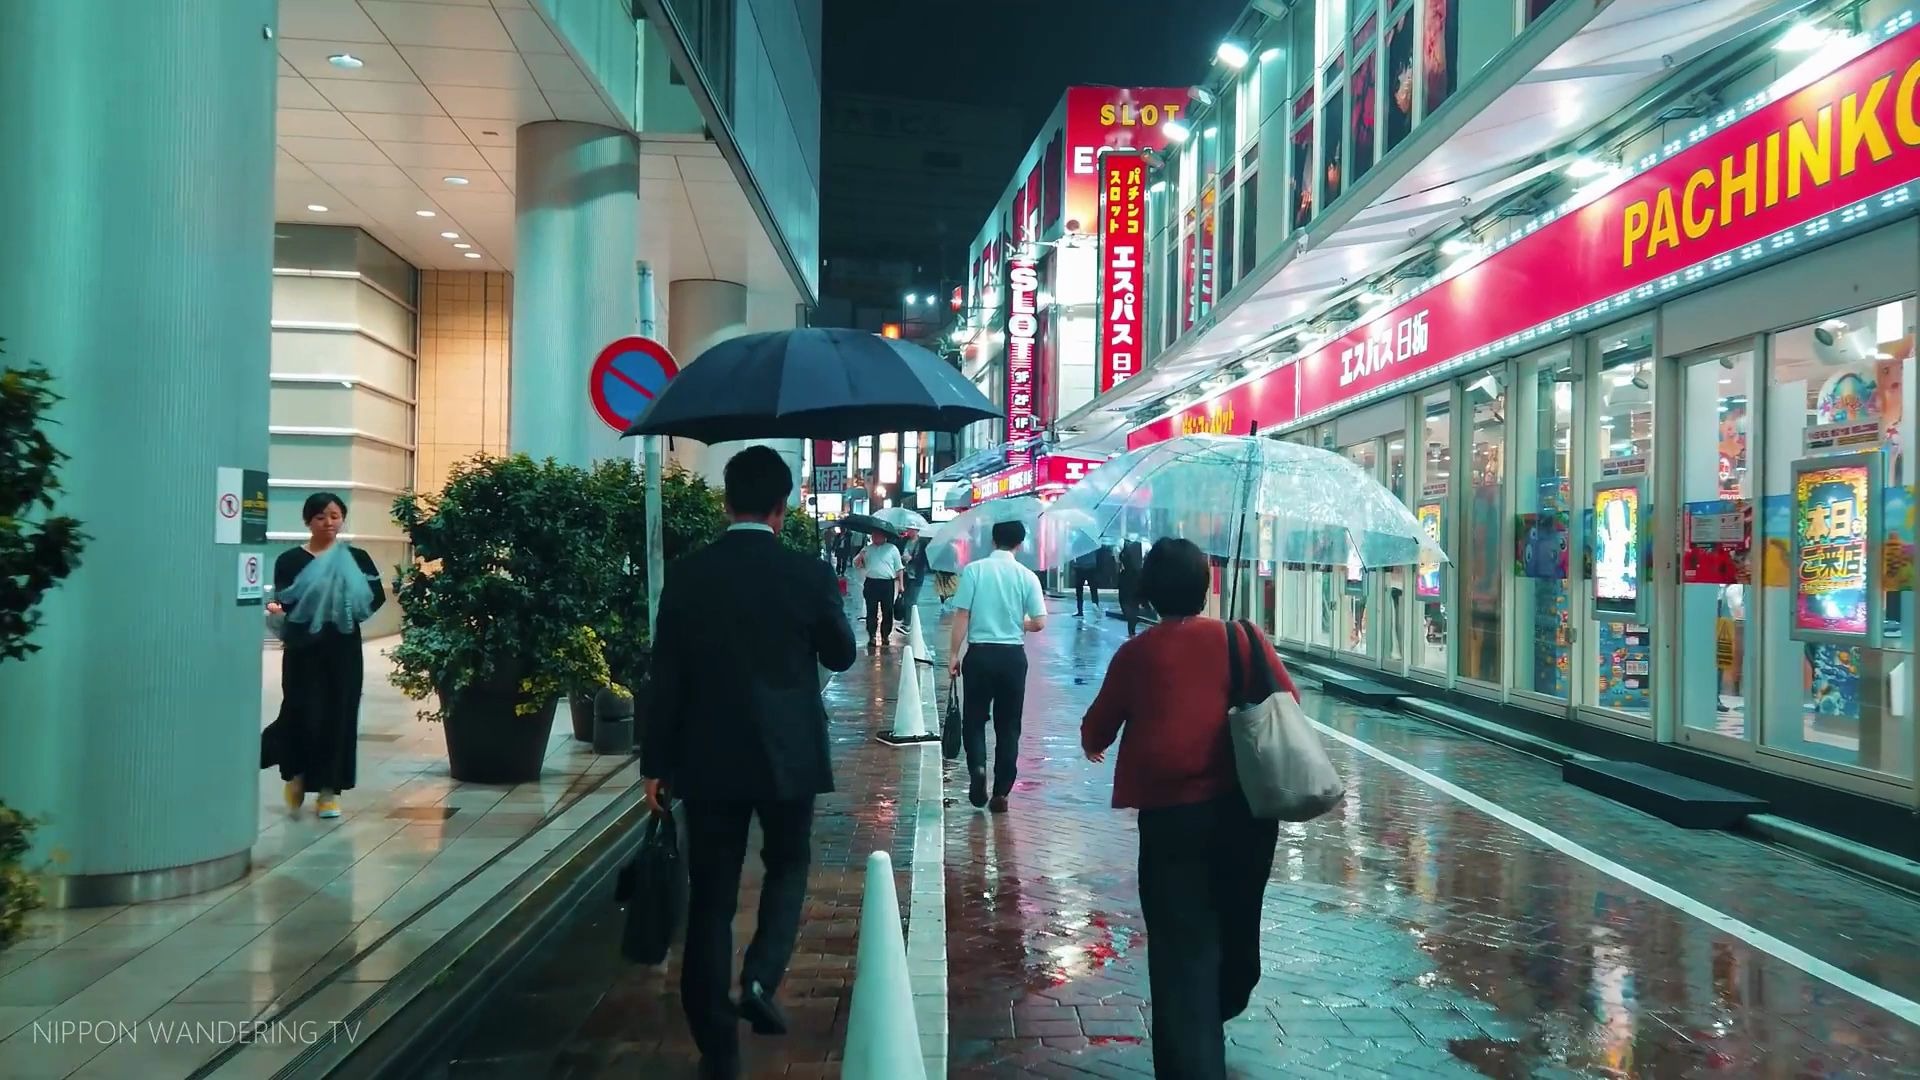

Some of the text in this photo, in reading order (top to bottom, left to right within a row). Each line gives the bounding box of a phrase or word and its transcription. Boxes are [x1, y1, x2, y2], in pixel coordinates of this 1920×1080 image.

[1100, 104, 1180, 126] SLOT
[1109, 170, 1122, 233] スロット
[1126, 167, 1141, 233] パチンコ
[1008, 268, 1038, 361] SLOT
[1014, 417, 1029, 429] 1F
